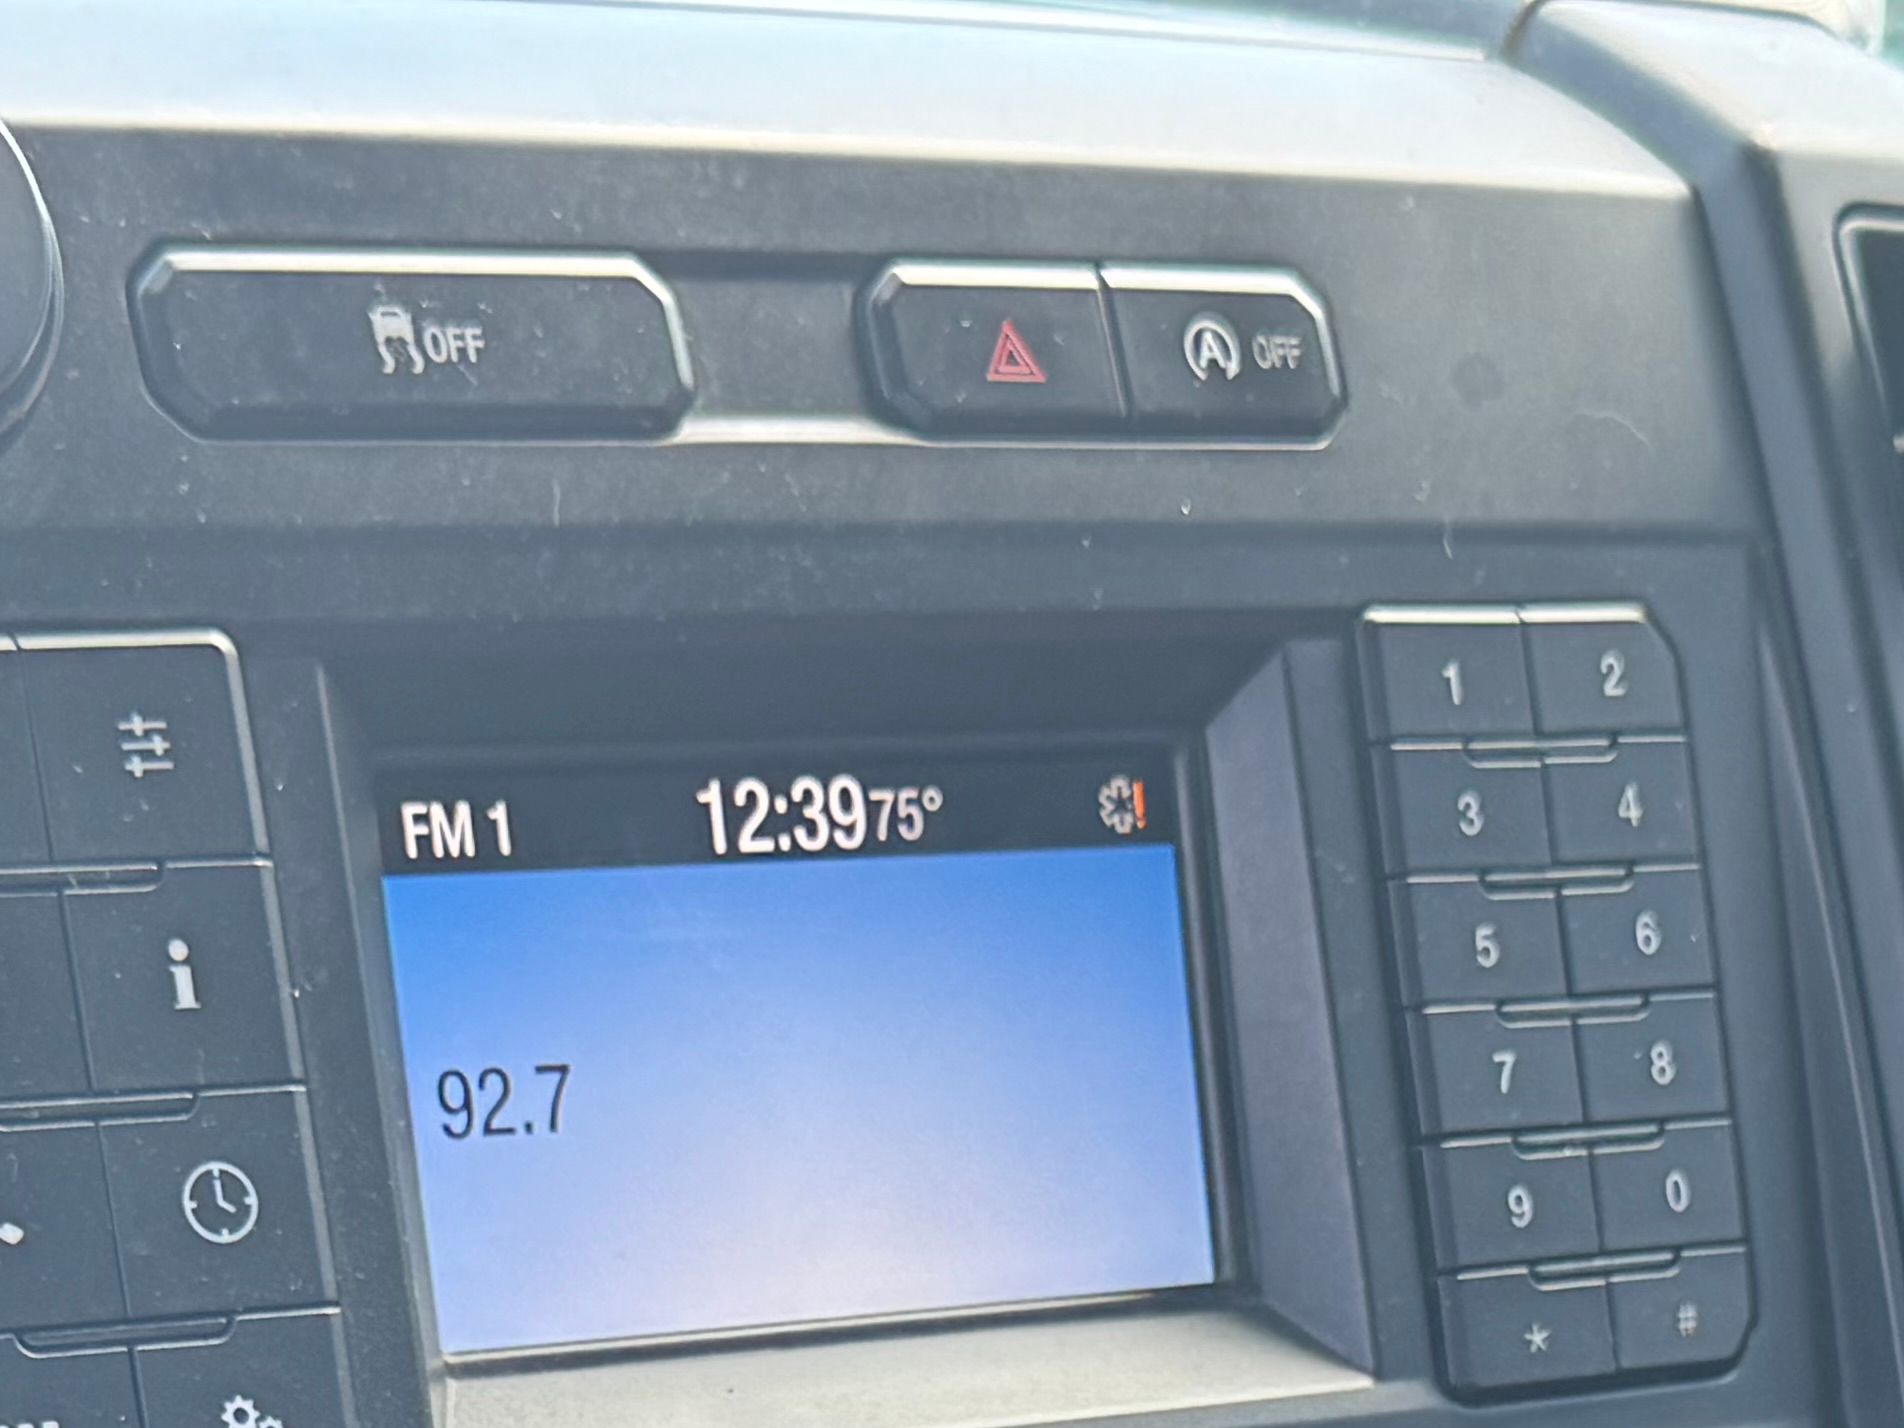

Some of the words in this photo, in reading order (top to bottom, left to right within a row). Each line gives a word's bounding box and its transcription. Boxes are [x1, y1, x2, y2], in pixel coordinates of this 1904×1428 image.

[424, 322, 486, 367] OFF
[1251, 332, 1302, 370] OFF
[1442, 660, 1463, 706] 1
[1600, 650, 1627, 697] 2
[696, 772, 867, 856] 12:39
[1458, 790, 1484, 836] 3
[1618, 782, 1643, 828] 4
[400, 801, 475, 859] FM
[487, 799, 513, 858] 1
[1475, 923, 1500, 968] 5
[1635, 911, 1661, 956] 6
[1492, 1050, 1517, 1094] 7
[1650, 1040, 1676, 1086] 8
[436, 1064, 571, 1142] 92.7
[1508, 1185, 1533, 1229] 9
[1666, 1169, 1691, 1213] 0
